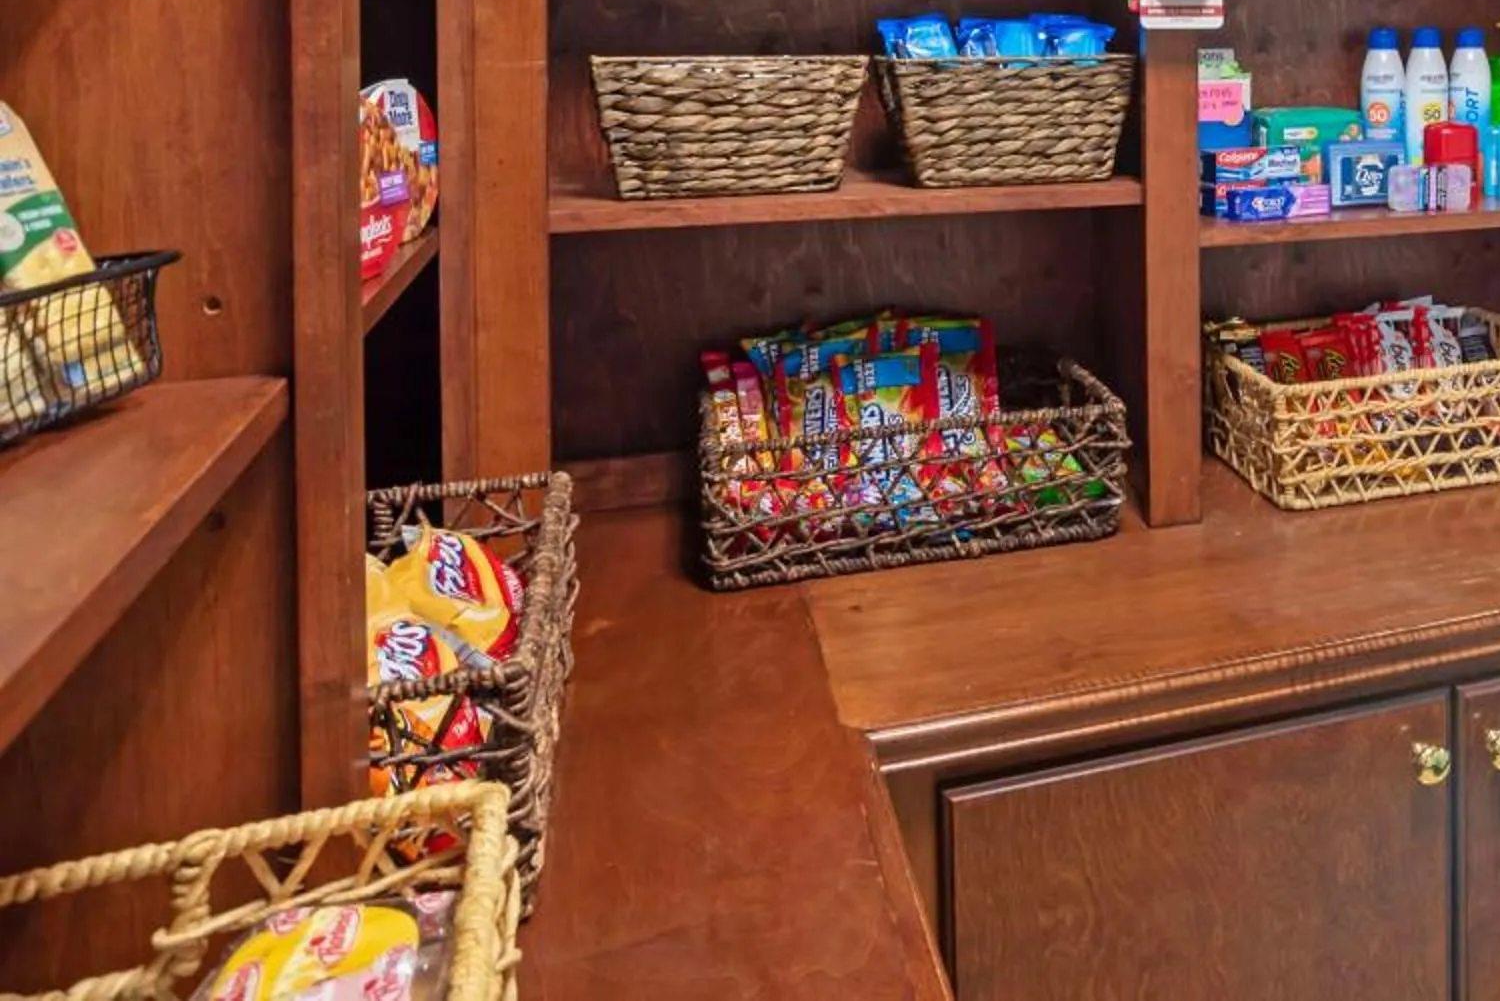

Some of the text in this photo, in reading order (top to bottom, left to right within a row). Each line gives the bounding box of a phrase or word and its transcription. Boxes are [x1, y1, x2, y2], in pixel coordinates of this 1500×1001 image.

[1466, 87, 1479, 123] ORT
[1369, 108, 1387, 123] 50
[1423, 110, 1441, 121] 50
